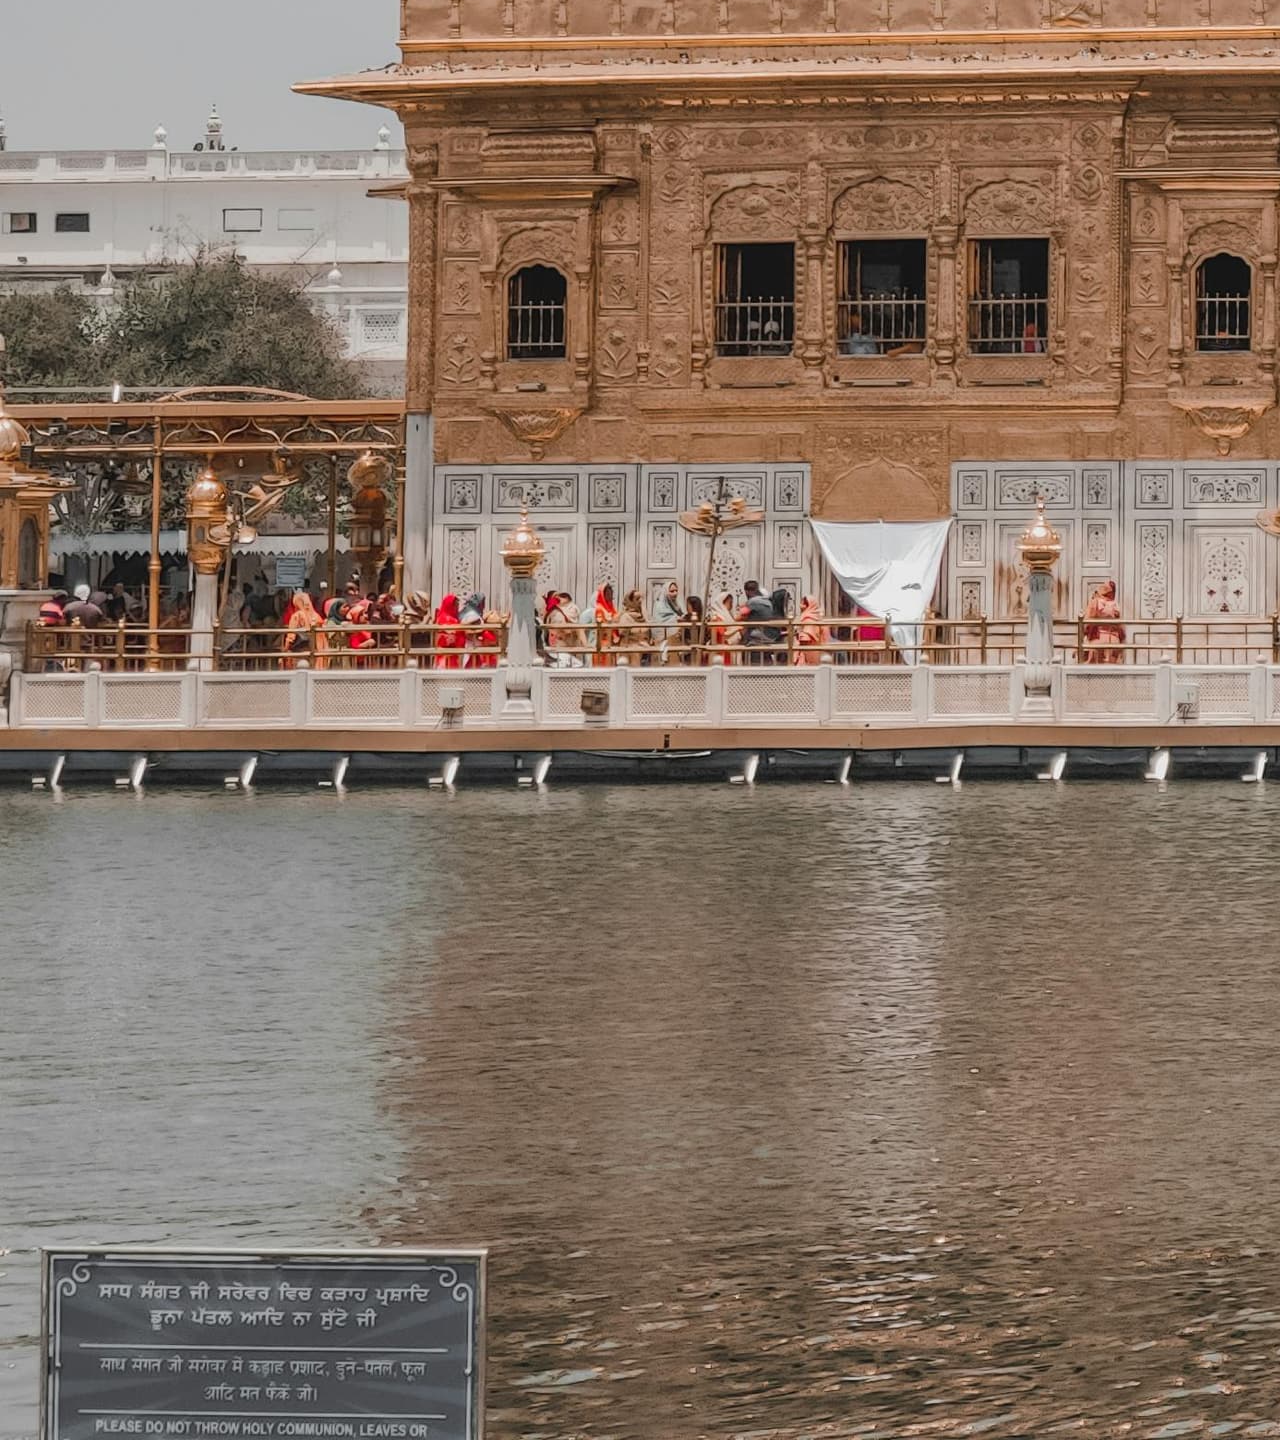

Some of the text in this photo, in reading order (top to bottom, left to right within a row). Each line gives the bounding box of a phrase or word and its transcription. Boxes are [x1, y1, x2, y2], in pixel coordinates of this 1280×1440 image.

[98, 1283, 134, 1299] ਸਾਧ
[139, 1280, 182, 1300] ਸੰਗਤ
[188, 1281, 211, 1300] ਜੀ
[217, 1281, 272, 1301] ਸਰੋਵਰ
[276, 1282, 313, 1301] ਵਿਚ
[319, 1287, 368, 1302] ਕੜਾਹ
[238, 1306, 286, 1326] ਆਦਿ
[291, 1311, 313, 1326] ਨਾ
[355, 1308, 377, 1327] ਜੀ
[99, 1357, 128, 1371] साध
[131, 1354, 163, 1372] संगत
[167, 1354, 184, 1372] जी
[187, 1355, 228, 1373] सरोवर
[231, 1356, 244, 1373] में
[239, 1386, 262, 1400] मत
[95, 1417, 429, 1439] PLEASE DO NOT THROW HOLY COMMUNION, LEAVES OR
